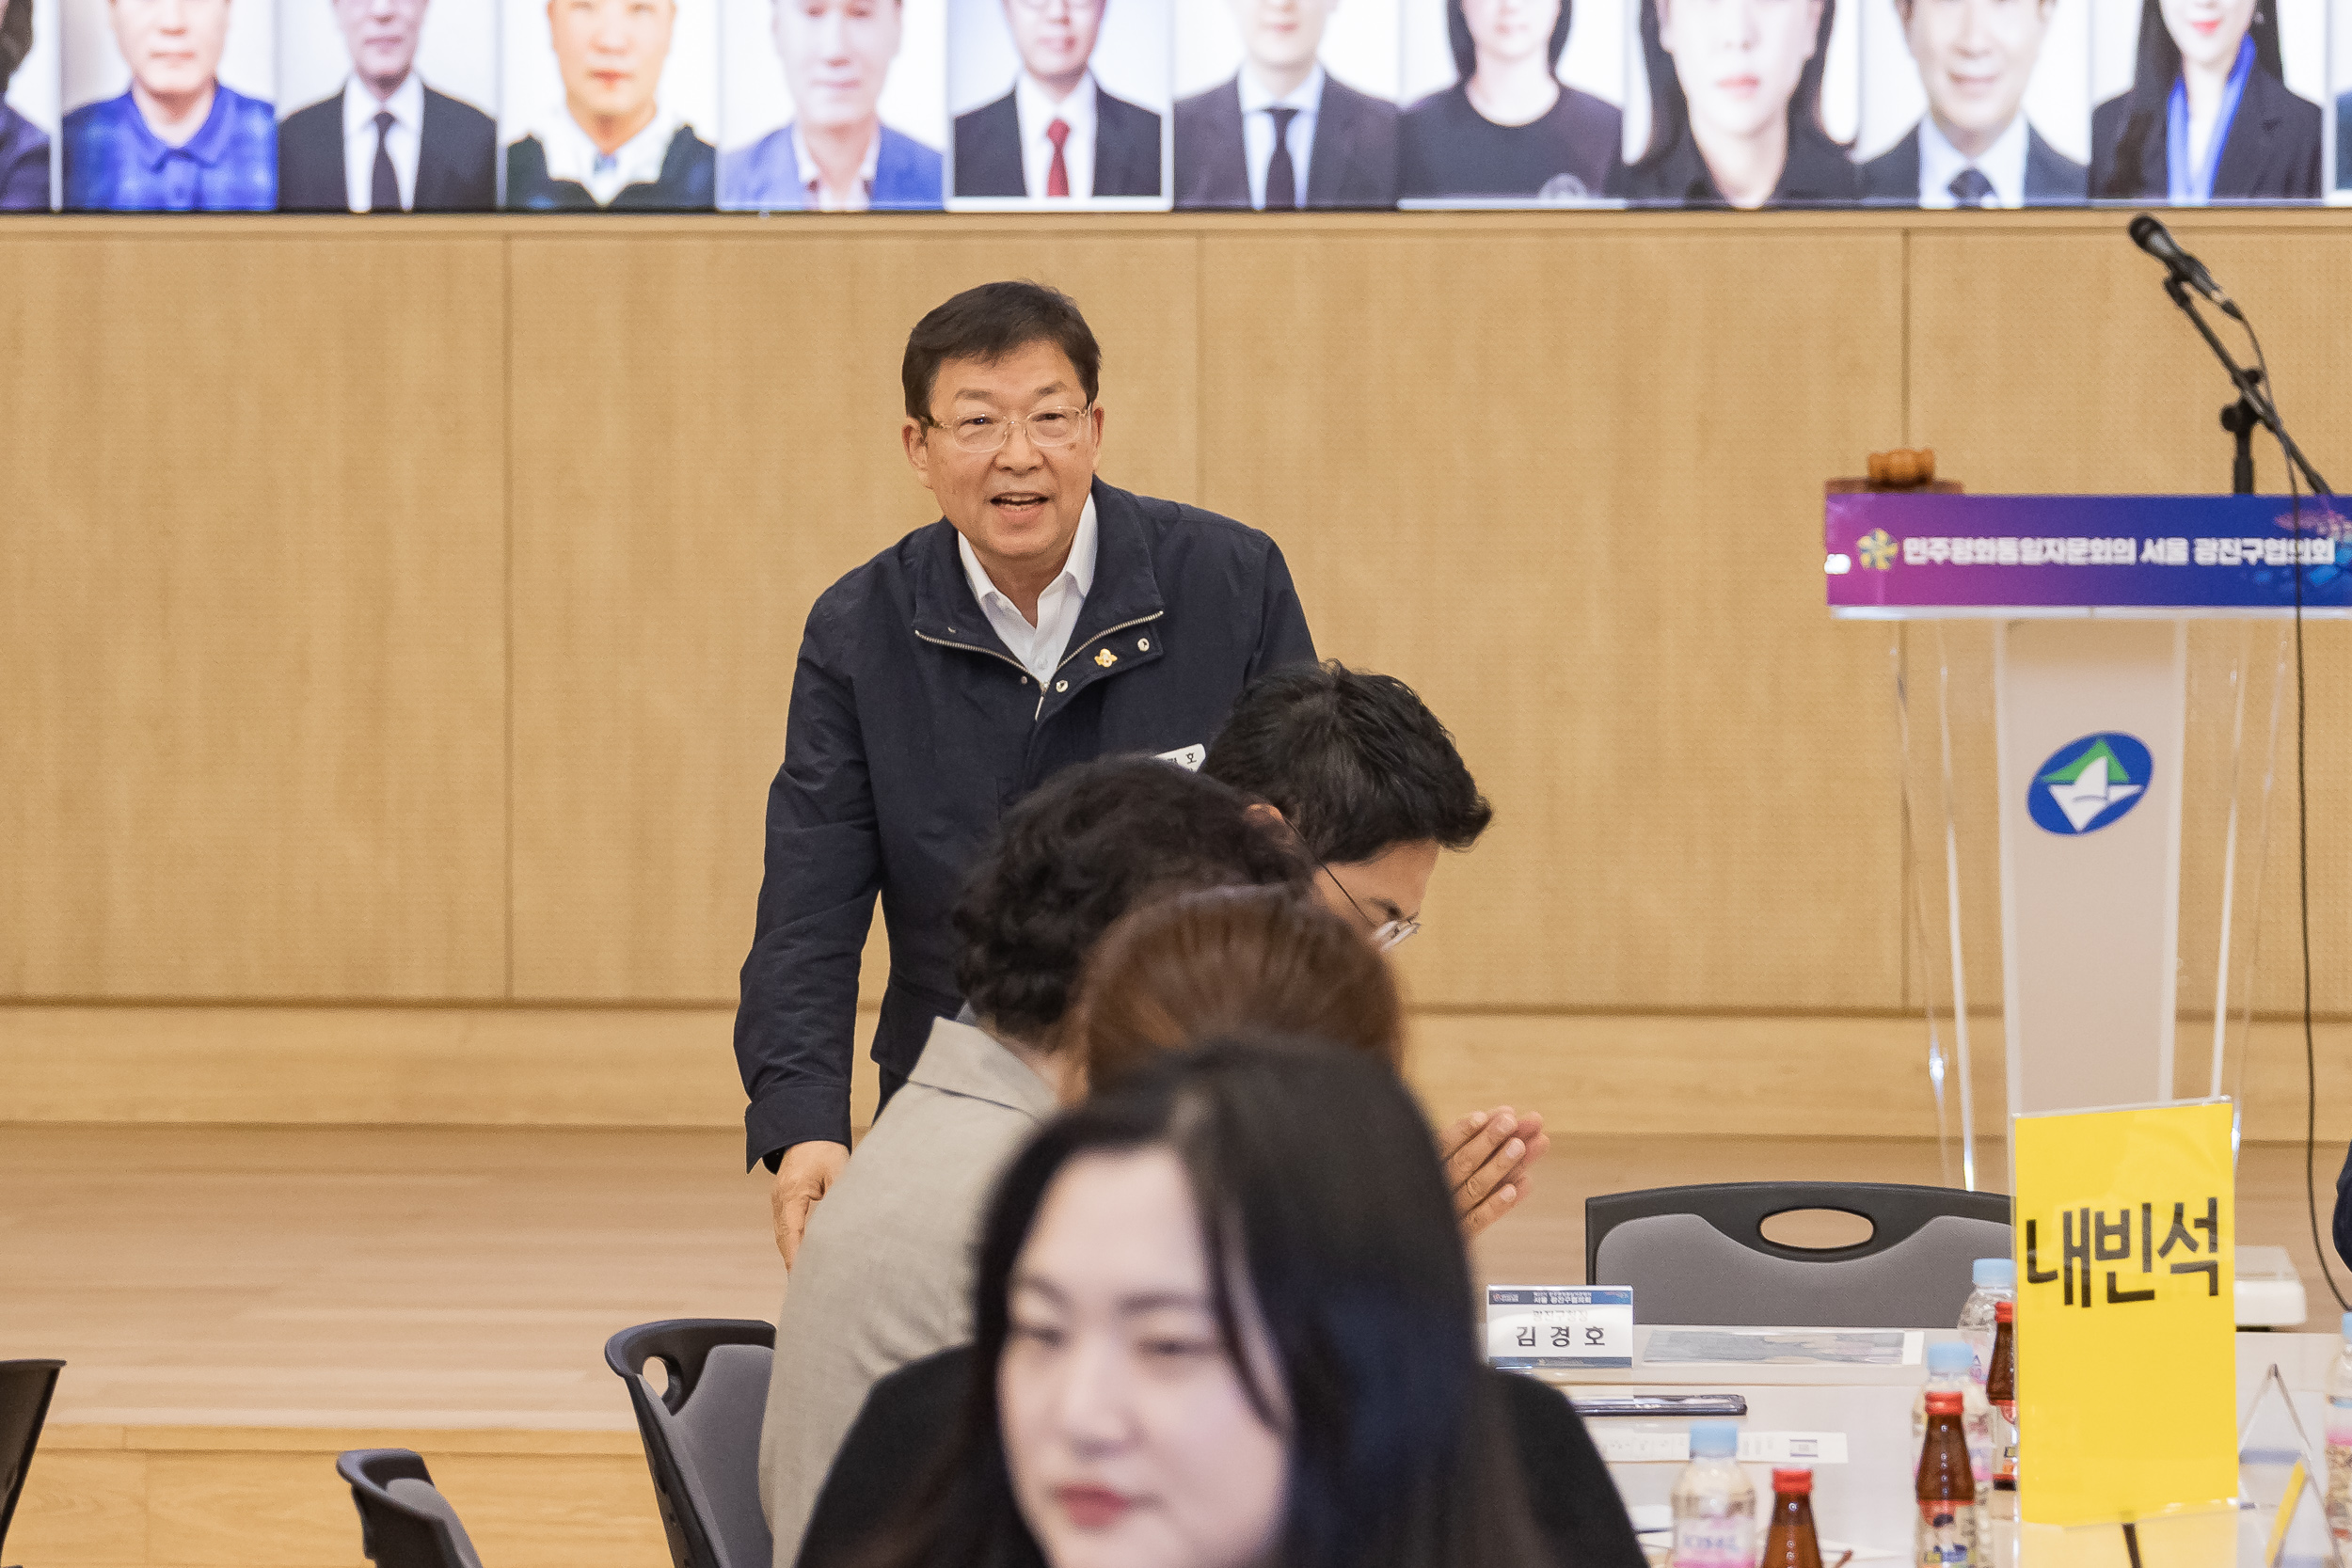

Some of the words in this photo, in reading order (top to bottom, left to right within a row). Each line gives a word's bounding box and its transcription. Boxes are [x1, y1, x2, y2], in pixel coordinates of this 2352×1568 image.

[1903, 536, 2137, 565] 민주평화통일자문회의
[2139, 537, 2189, 565] 서울
[2194, 537, 2336, 565] 광진구협의회
[2026, 1196, 2218, 1308] 내빈석
